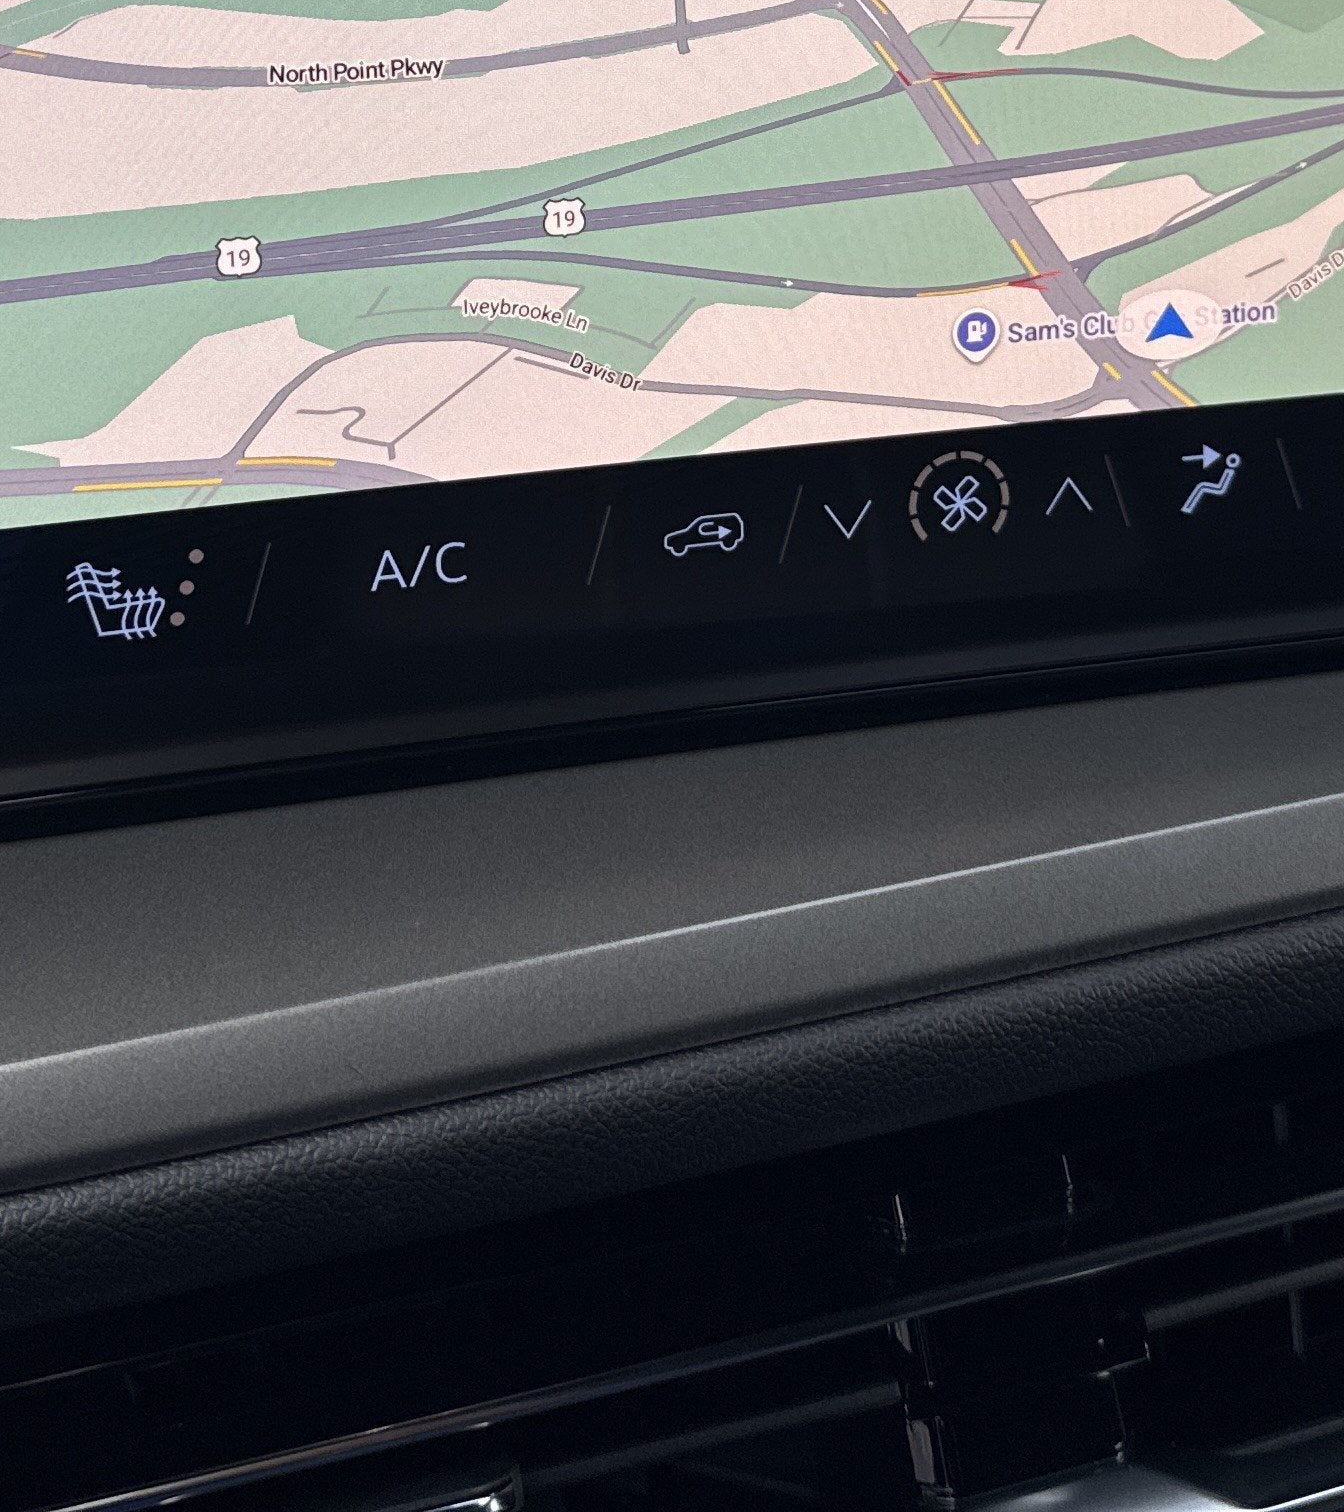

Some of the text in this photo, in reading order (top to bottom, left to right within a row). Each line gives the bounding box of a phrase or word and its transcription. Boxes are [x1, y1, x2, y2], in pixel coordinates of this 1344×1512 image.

[269, 57, 444, 84] North Point Pkwy
[552, 209, 576, 229] 19
[226, 248, 251, 269] 19
[1287, 259, 1331, 300] Davis
[462, 297, 589, 332] Iveybrooke Ln
[1008, 318, 1076, 343] Sam's
[1082, 315, 1135, 338] Club
[1195, 302, 1276, 328] Station
[569, 352, 641, 391] Davis Dr
[369, 541, 469, 595] A/C
